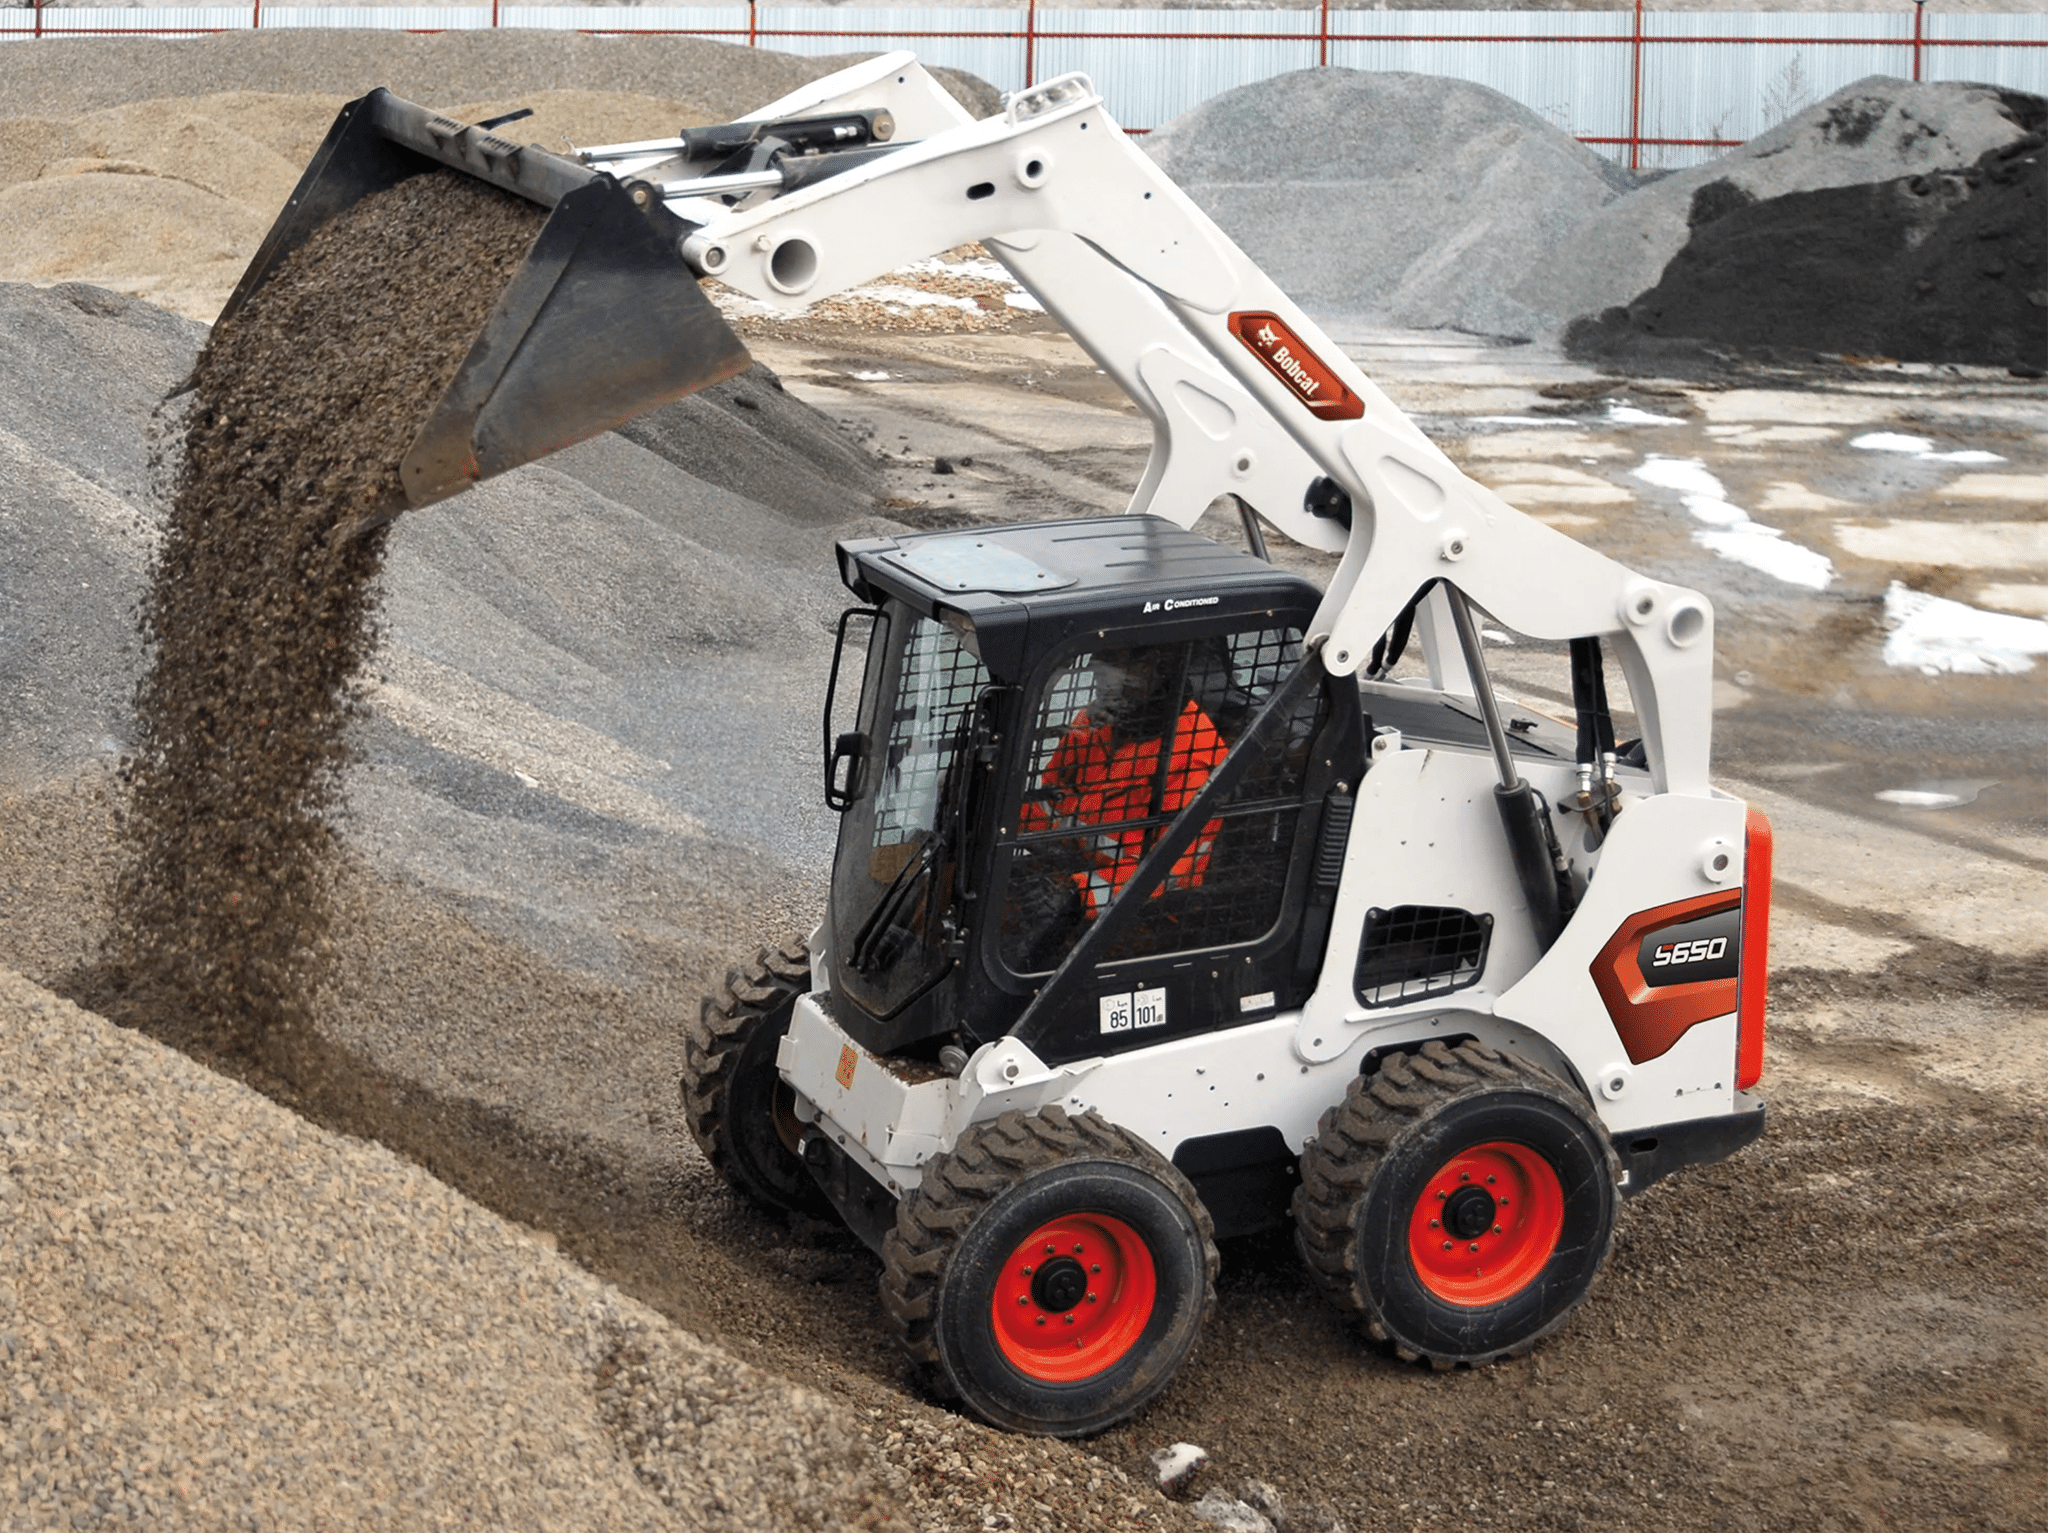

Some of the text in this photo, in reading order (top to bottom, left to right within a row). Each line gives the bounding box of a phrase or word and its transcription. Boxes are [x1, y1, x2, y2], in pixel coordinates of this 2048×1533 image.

[1273, 346, 1320, 396] Bobcat
[1652, 937, 1728, 967] S650
[1110, 1010, 1128, 1029] 85
[1136, 1005, 1156, 1025] 101
